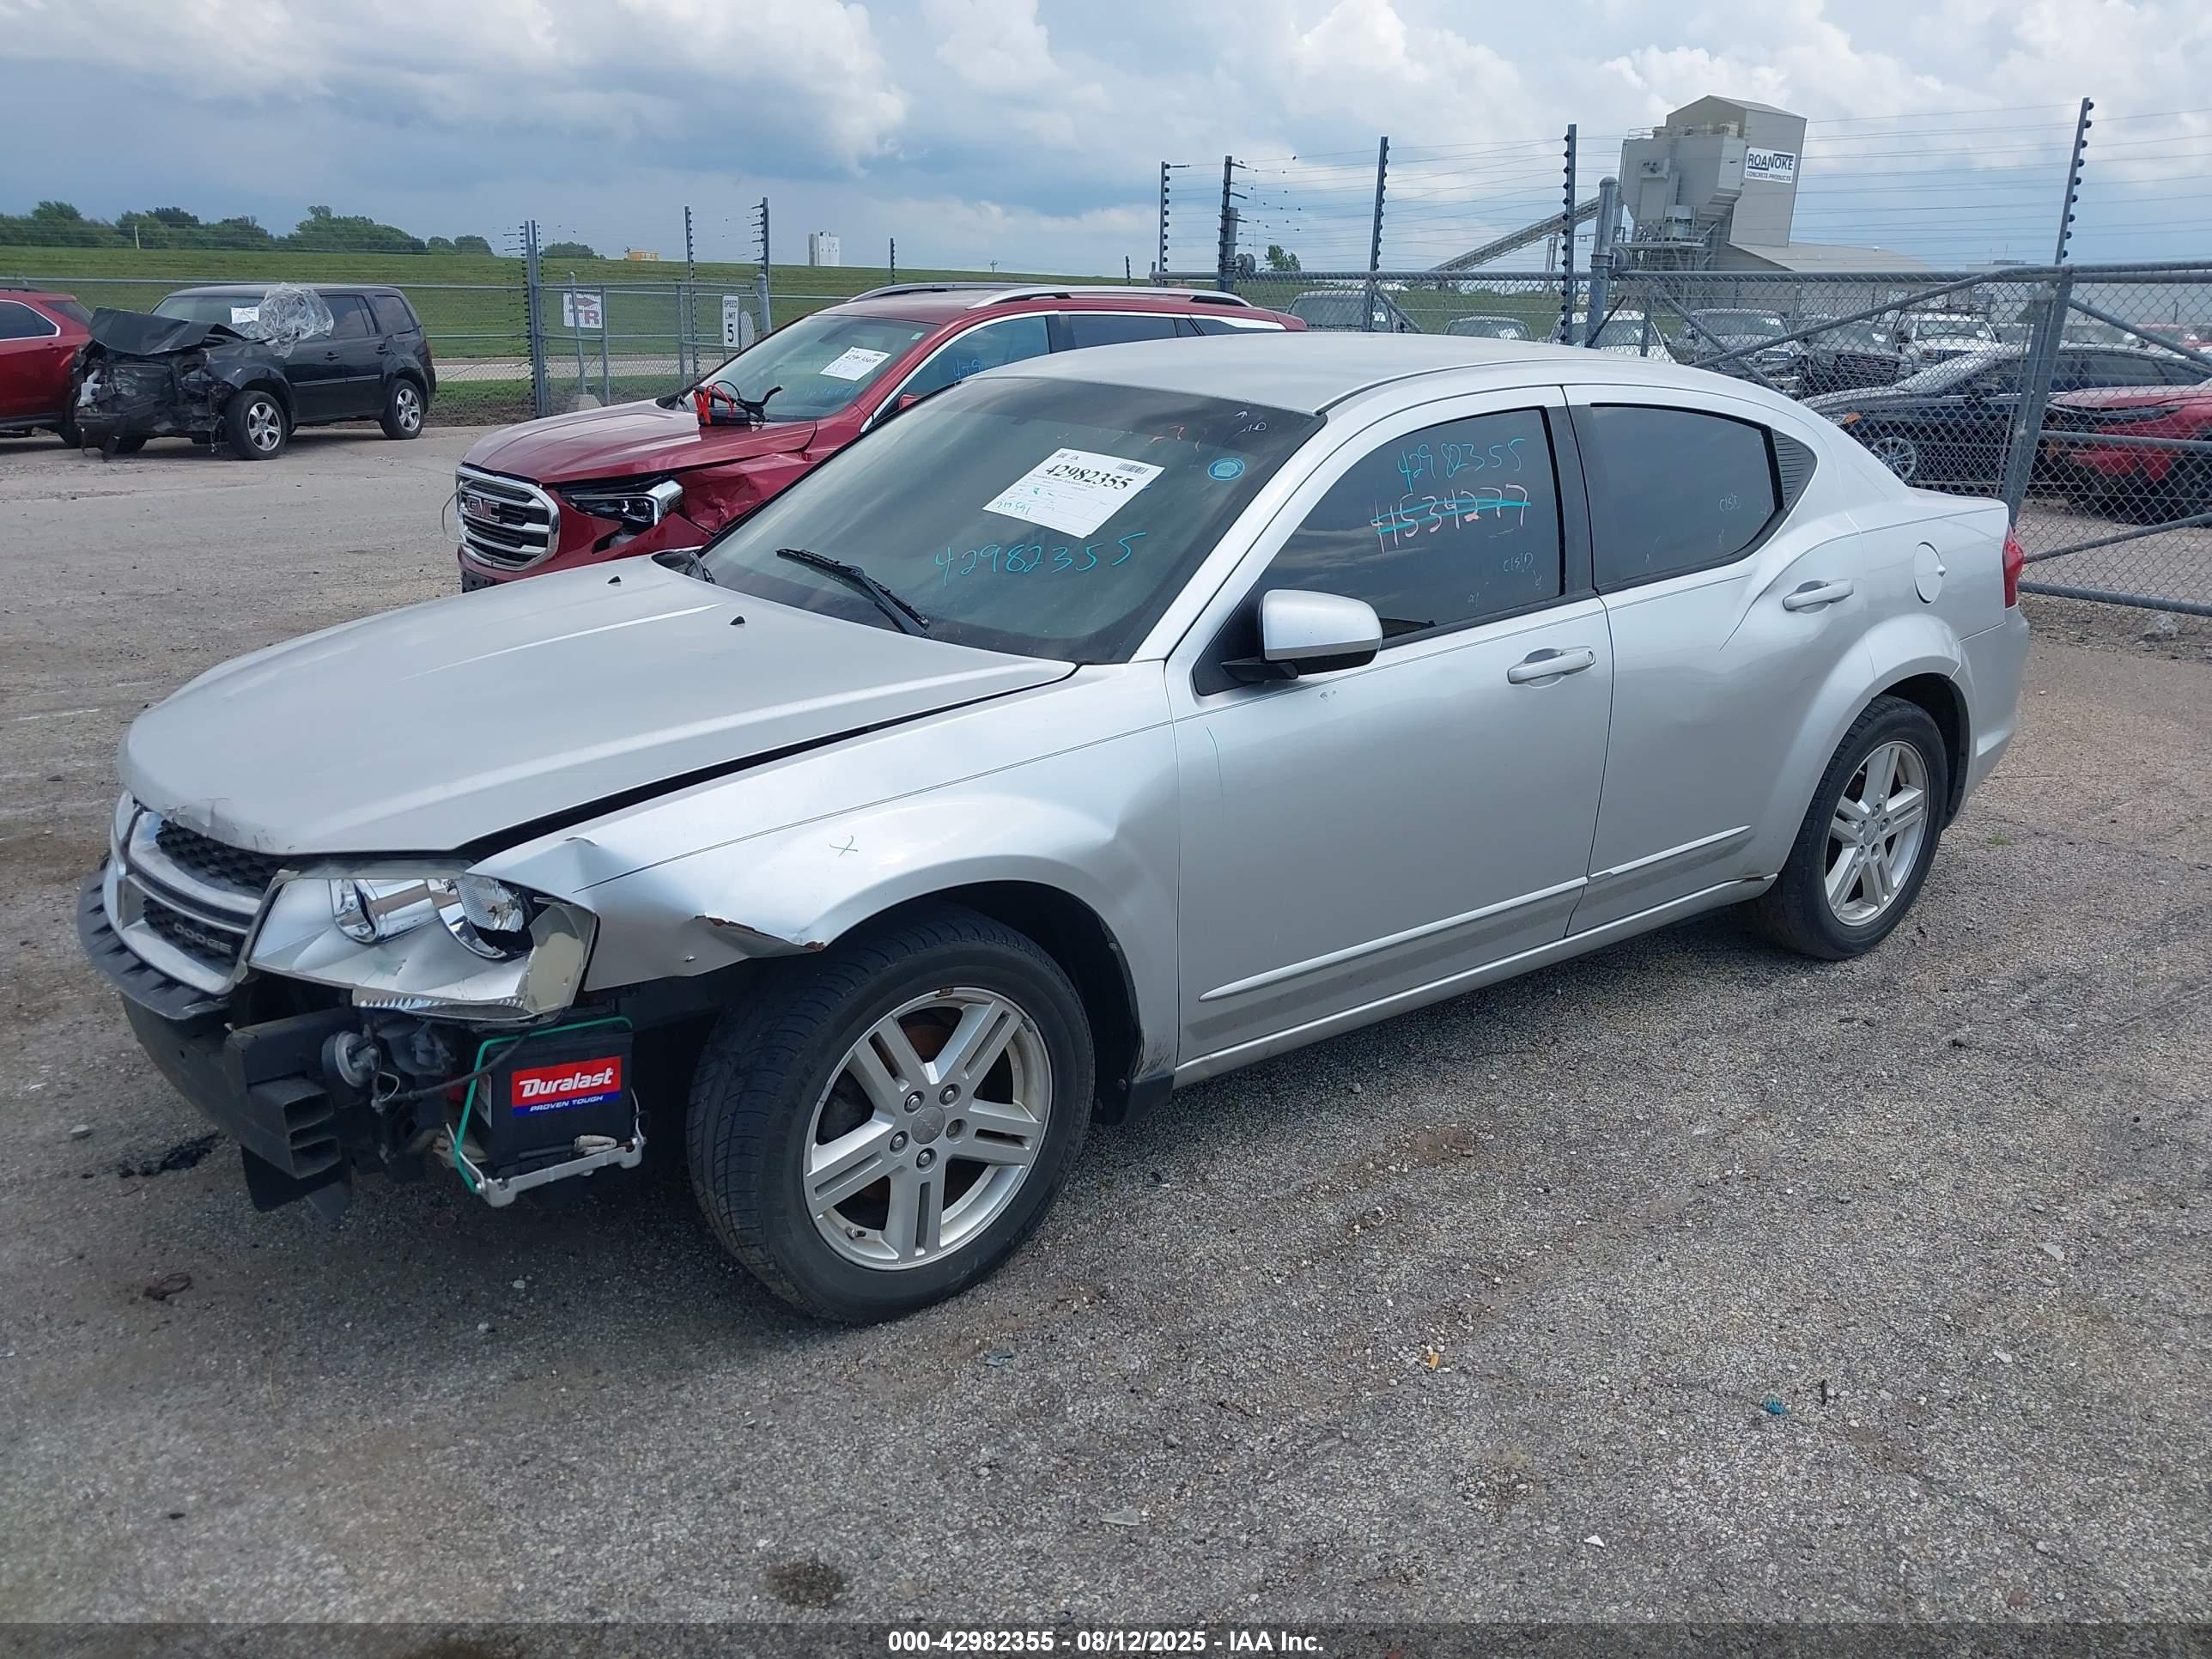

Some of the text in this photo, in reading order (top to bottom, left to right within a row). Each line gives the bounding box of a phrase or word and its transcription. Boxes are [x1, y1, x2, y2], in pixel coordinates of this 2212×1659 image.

[1747, 153, 1794, 171] ROANOKE
[1746, 170, 1791, 182] CONCRETE PRODUCTS
[724, 299, 737, 308] SPEED
[725, 311, 736, 320] LIMIT
[727, 323, 734, 343] 5
[1045, 464, 1134, 490] 42982355
[1397, 438, 1526, 495] 42982355
[465, 494, 501, 523] GMC
[934, 531, 1147, 587] 42982355
[173, 921, 233, 954] DODGE
[518, 1066, 614, 1098] Duralast
[529, 1095, 604, 1113] PROVEN TOUGH
